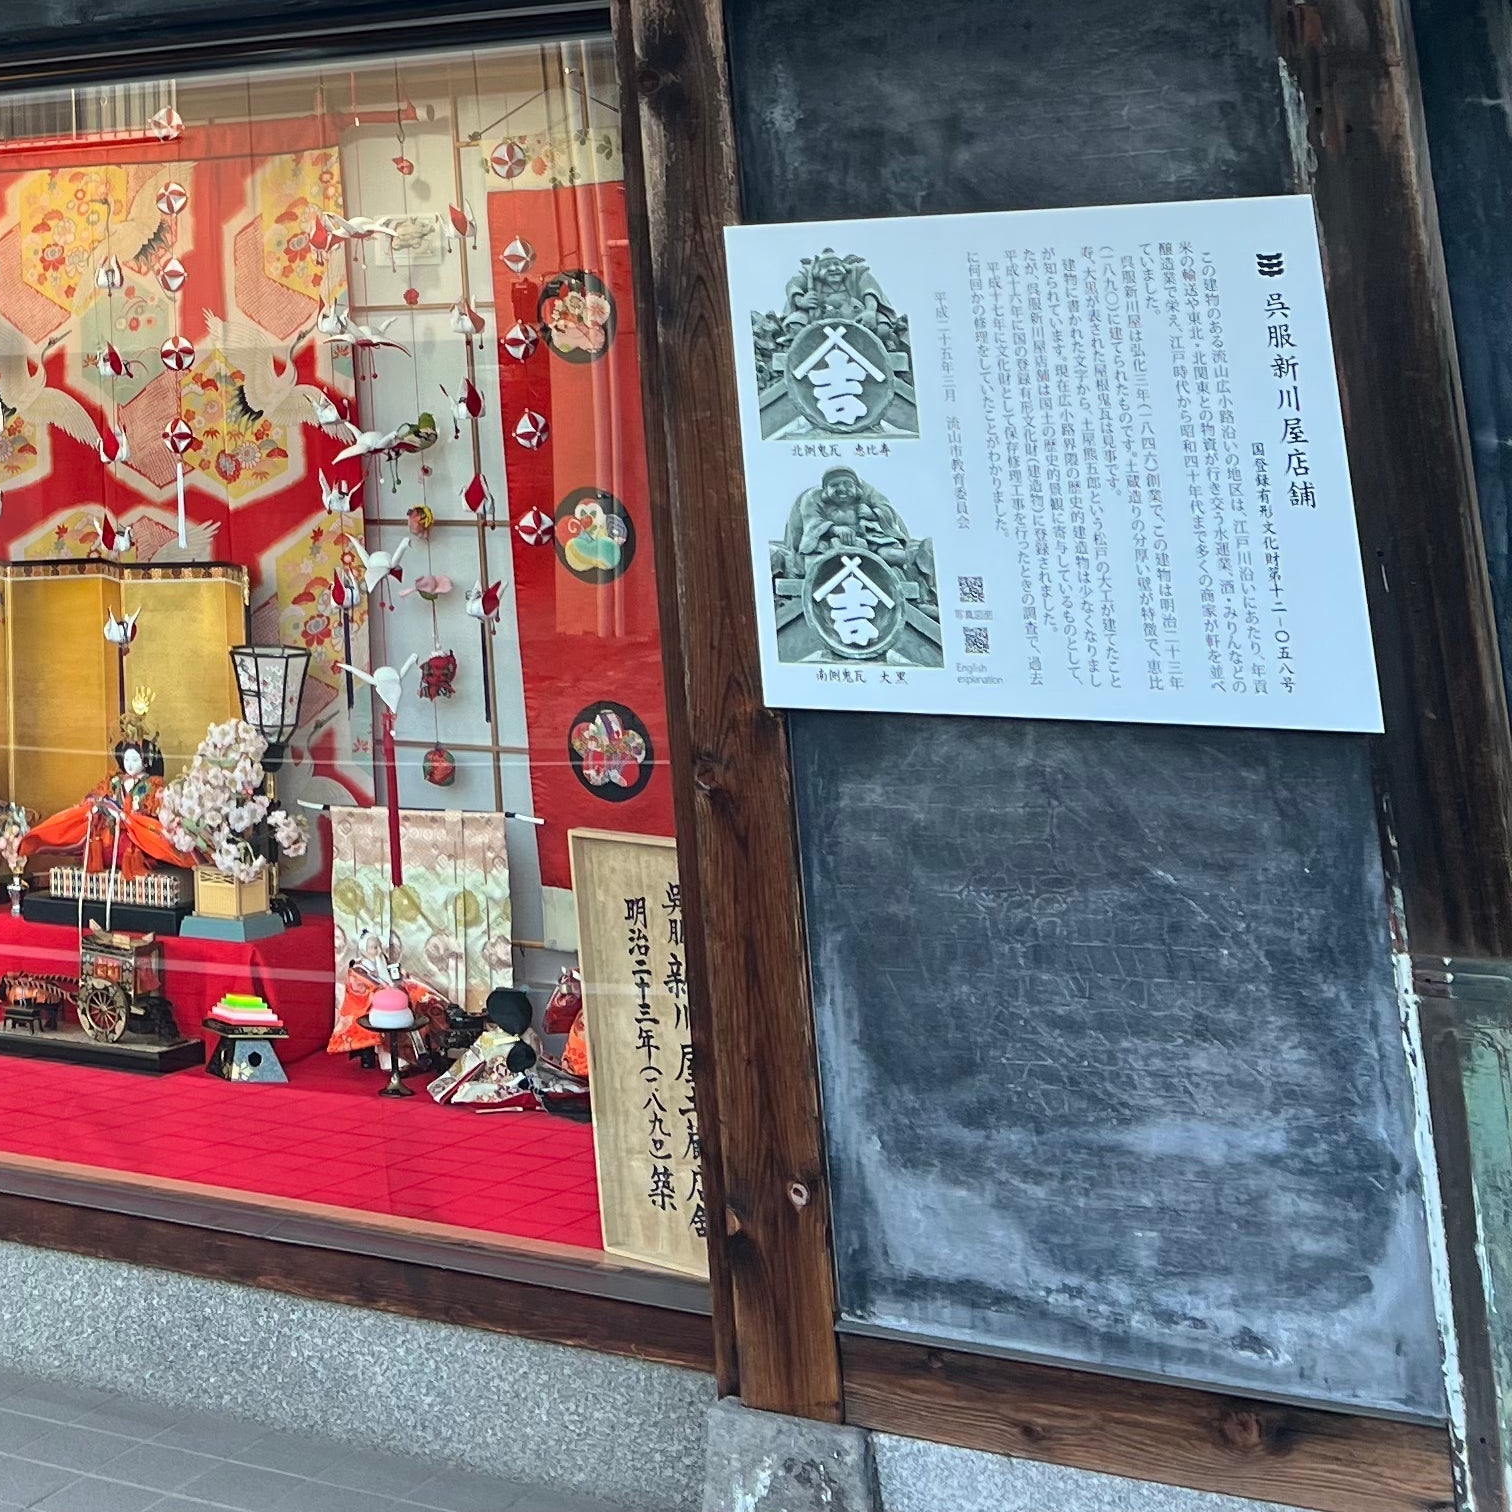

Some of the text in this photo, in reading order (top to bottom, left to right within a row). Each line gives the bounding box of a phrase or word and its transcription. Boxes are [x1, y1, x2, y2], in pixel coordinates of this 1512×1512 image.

[1138, 243, 1161, 315] ていました。
[933, 291, 971, 529] 平成二十五年三月 流山市教育委員会
[1264, 293, 1317, 509] 呉服新川屋店舗
[956, 662, 988, 675] English
[957, 675, 1005, 686] explanation
